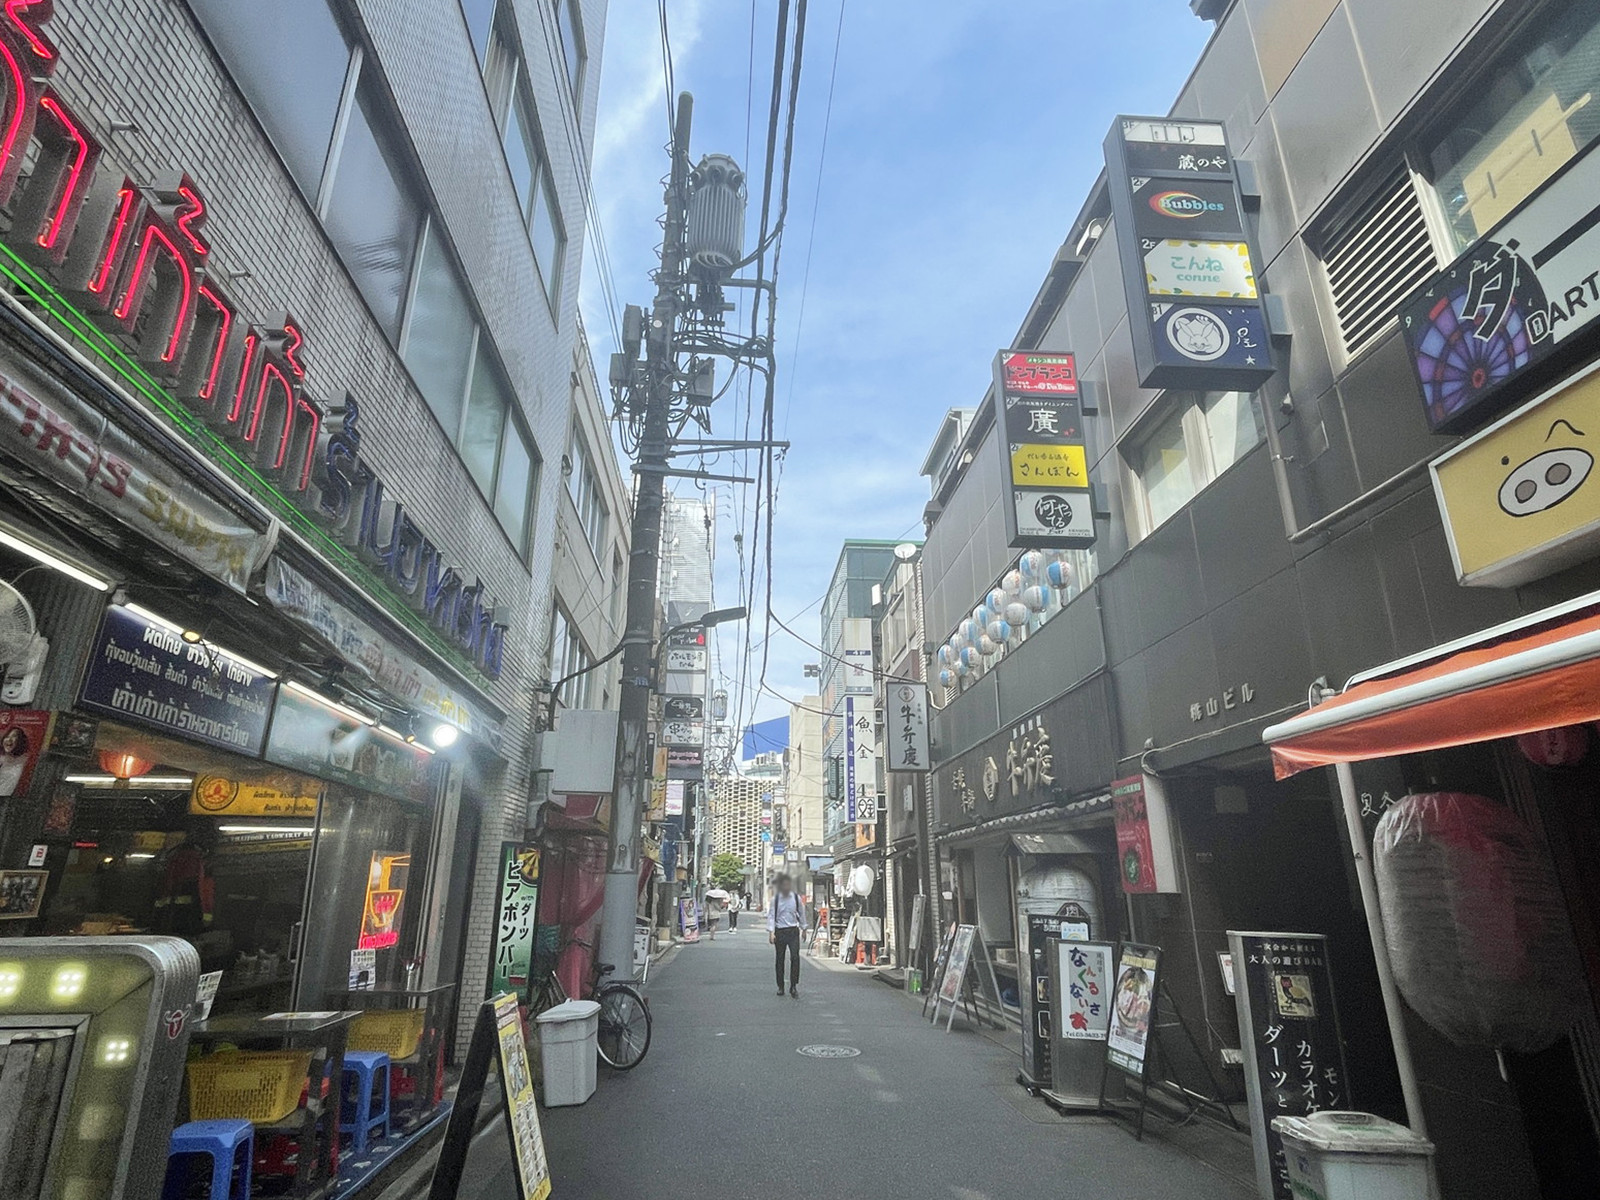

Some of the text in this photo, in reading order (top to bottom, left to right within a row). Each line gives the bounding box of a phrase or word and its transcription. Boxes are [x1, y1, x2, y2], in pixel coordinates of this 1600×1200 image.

[1178, 154, 1227, 172] 蔵のや
[1132, 177, 1145, 188] 2F
[1160, 199, 1225, 212] Bubbles
[1141, 238, 1156, 249] 2F
[1170, 256, 1224, 272] こんね
[1176, 273, 1220, 283] conne
[1005, 365, 1073, 380] ドンブランコ
[1027, 408, 1059, 434] 廣
[855, 716, 874, 759] 魚金
[900, 704, 921, 767] 牛弁慶
[498, 861, 524, 978] ビアポンバー
[519, 902, 532, 941] ダーツ
